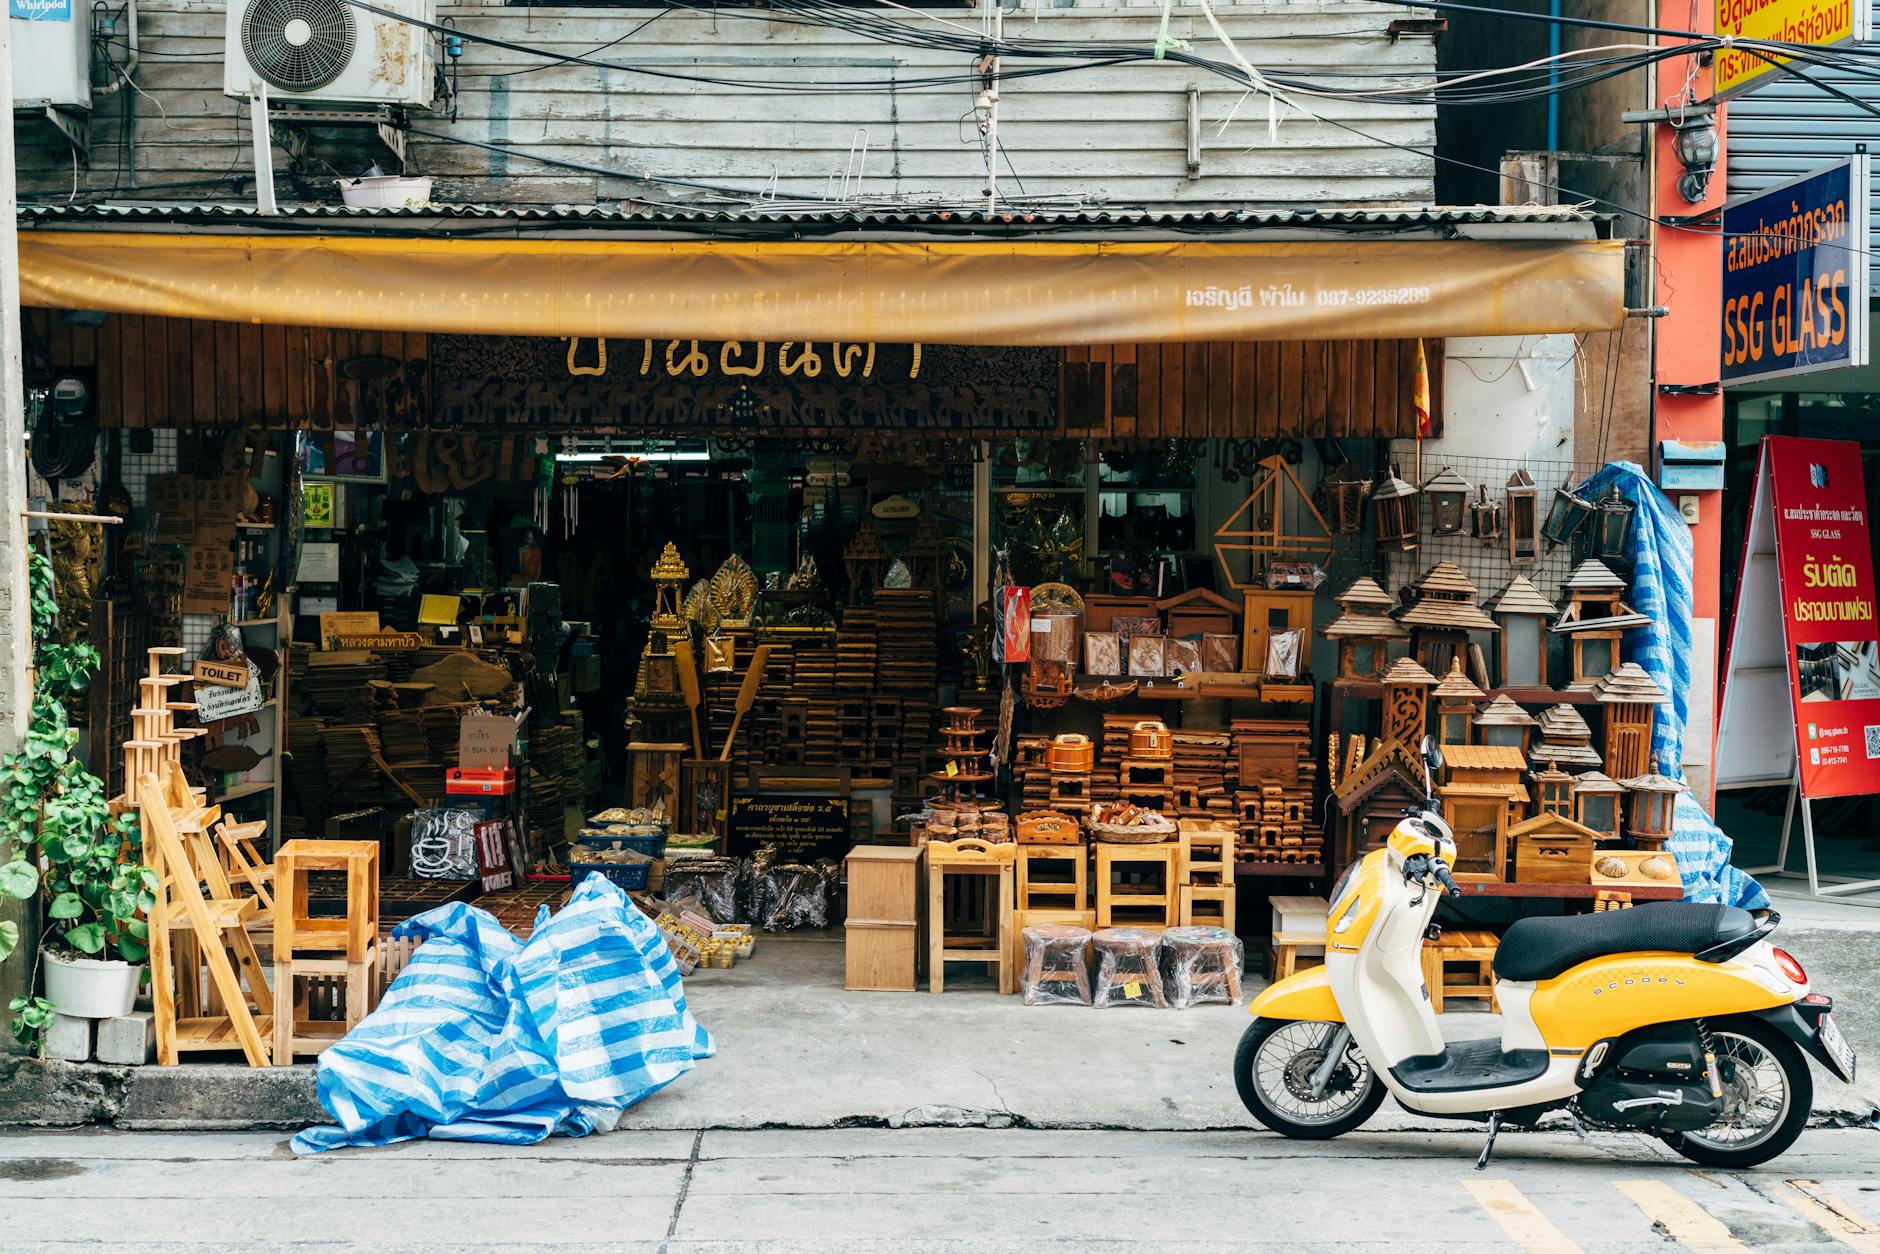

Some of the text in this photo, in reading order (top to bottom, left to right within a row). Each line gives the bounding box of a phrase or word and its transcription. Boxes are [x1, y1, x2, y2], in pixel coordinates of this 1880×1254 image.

[16, 0, 67, 10] Whirlpool
[1186, 285, 1253, 311] เจริญดี
[1317, 287, 1430, 307] 087-9236289
[1724, 269, 1846, 366] SSG GLASS
[1810, 529, 1841, 539] SSG GLASS
[1803, 554, 1857, 588] รับตัด
[1794, 596, 1873, 622] ประกอบบานเฟรม
[341, 635, 415, 648] หลวงตามหาบัว
[201, 667, 242, 682] TOILET
[1593, 977, 1686, 996] SCOOPY
